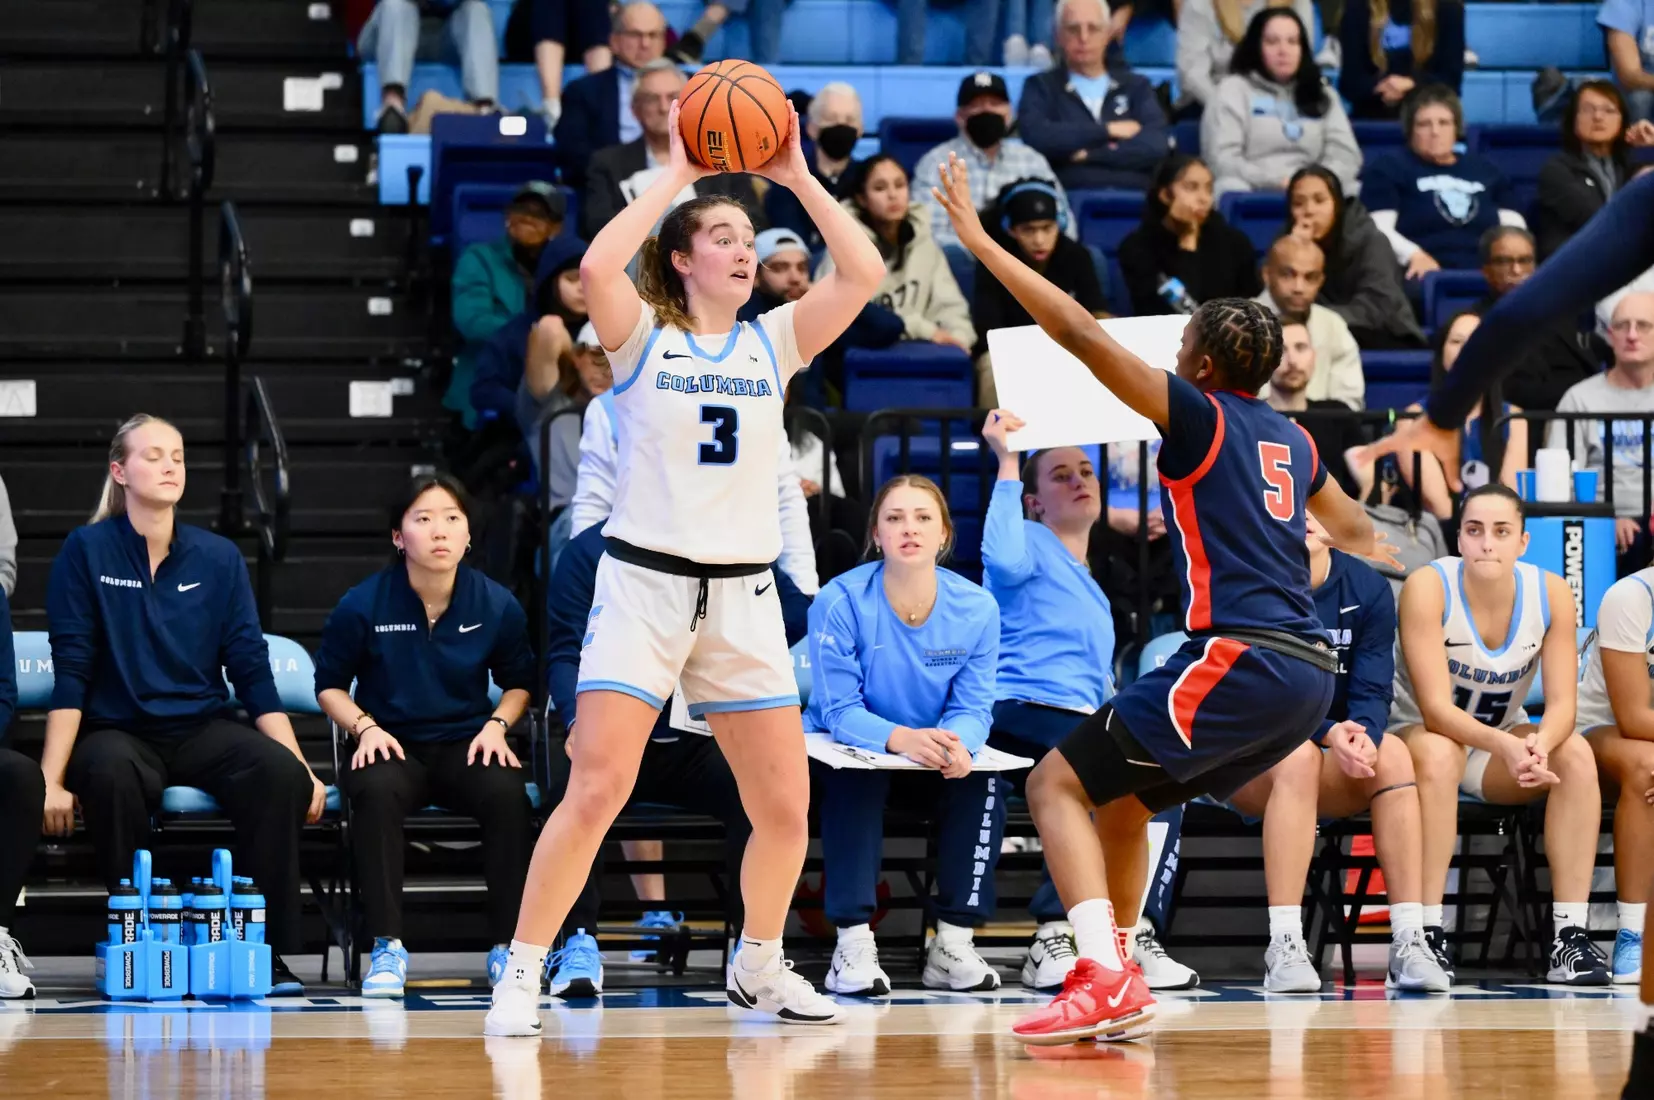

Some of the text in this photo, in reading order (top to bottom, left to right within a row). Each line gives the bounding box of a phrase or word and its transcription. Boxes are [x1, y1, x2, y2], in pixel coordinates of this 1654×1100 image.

[707, 130, 731, 171] ELITE
[656, 371, 772, 397] COLUMBIA
[698, 403, 739, 465] 3
[1258, 441, 1294, 521] 5
[100, 575, 142, 588] COLUMBIA
[374, 624, 417, 633] COLUMBIA
[1453, 684, 1513, 727] 15
[966, 778, 996, 906] COLUMBIA
